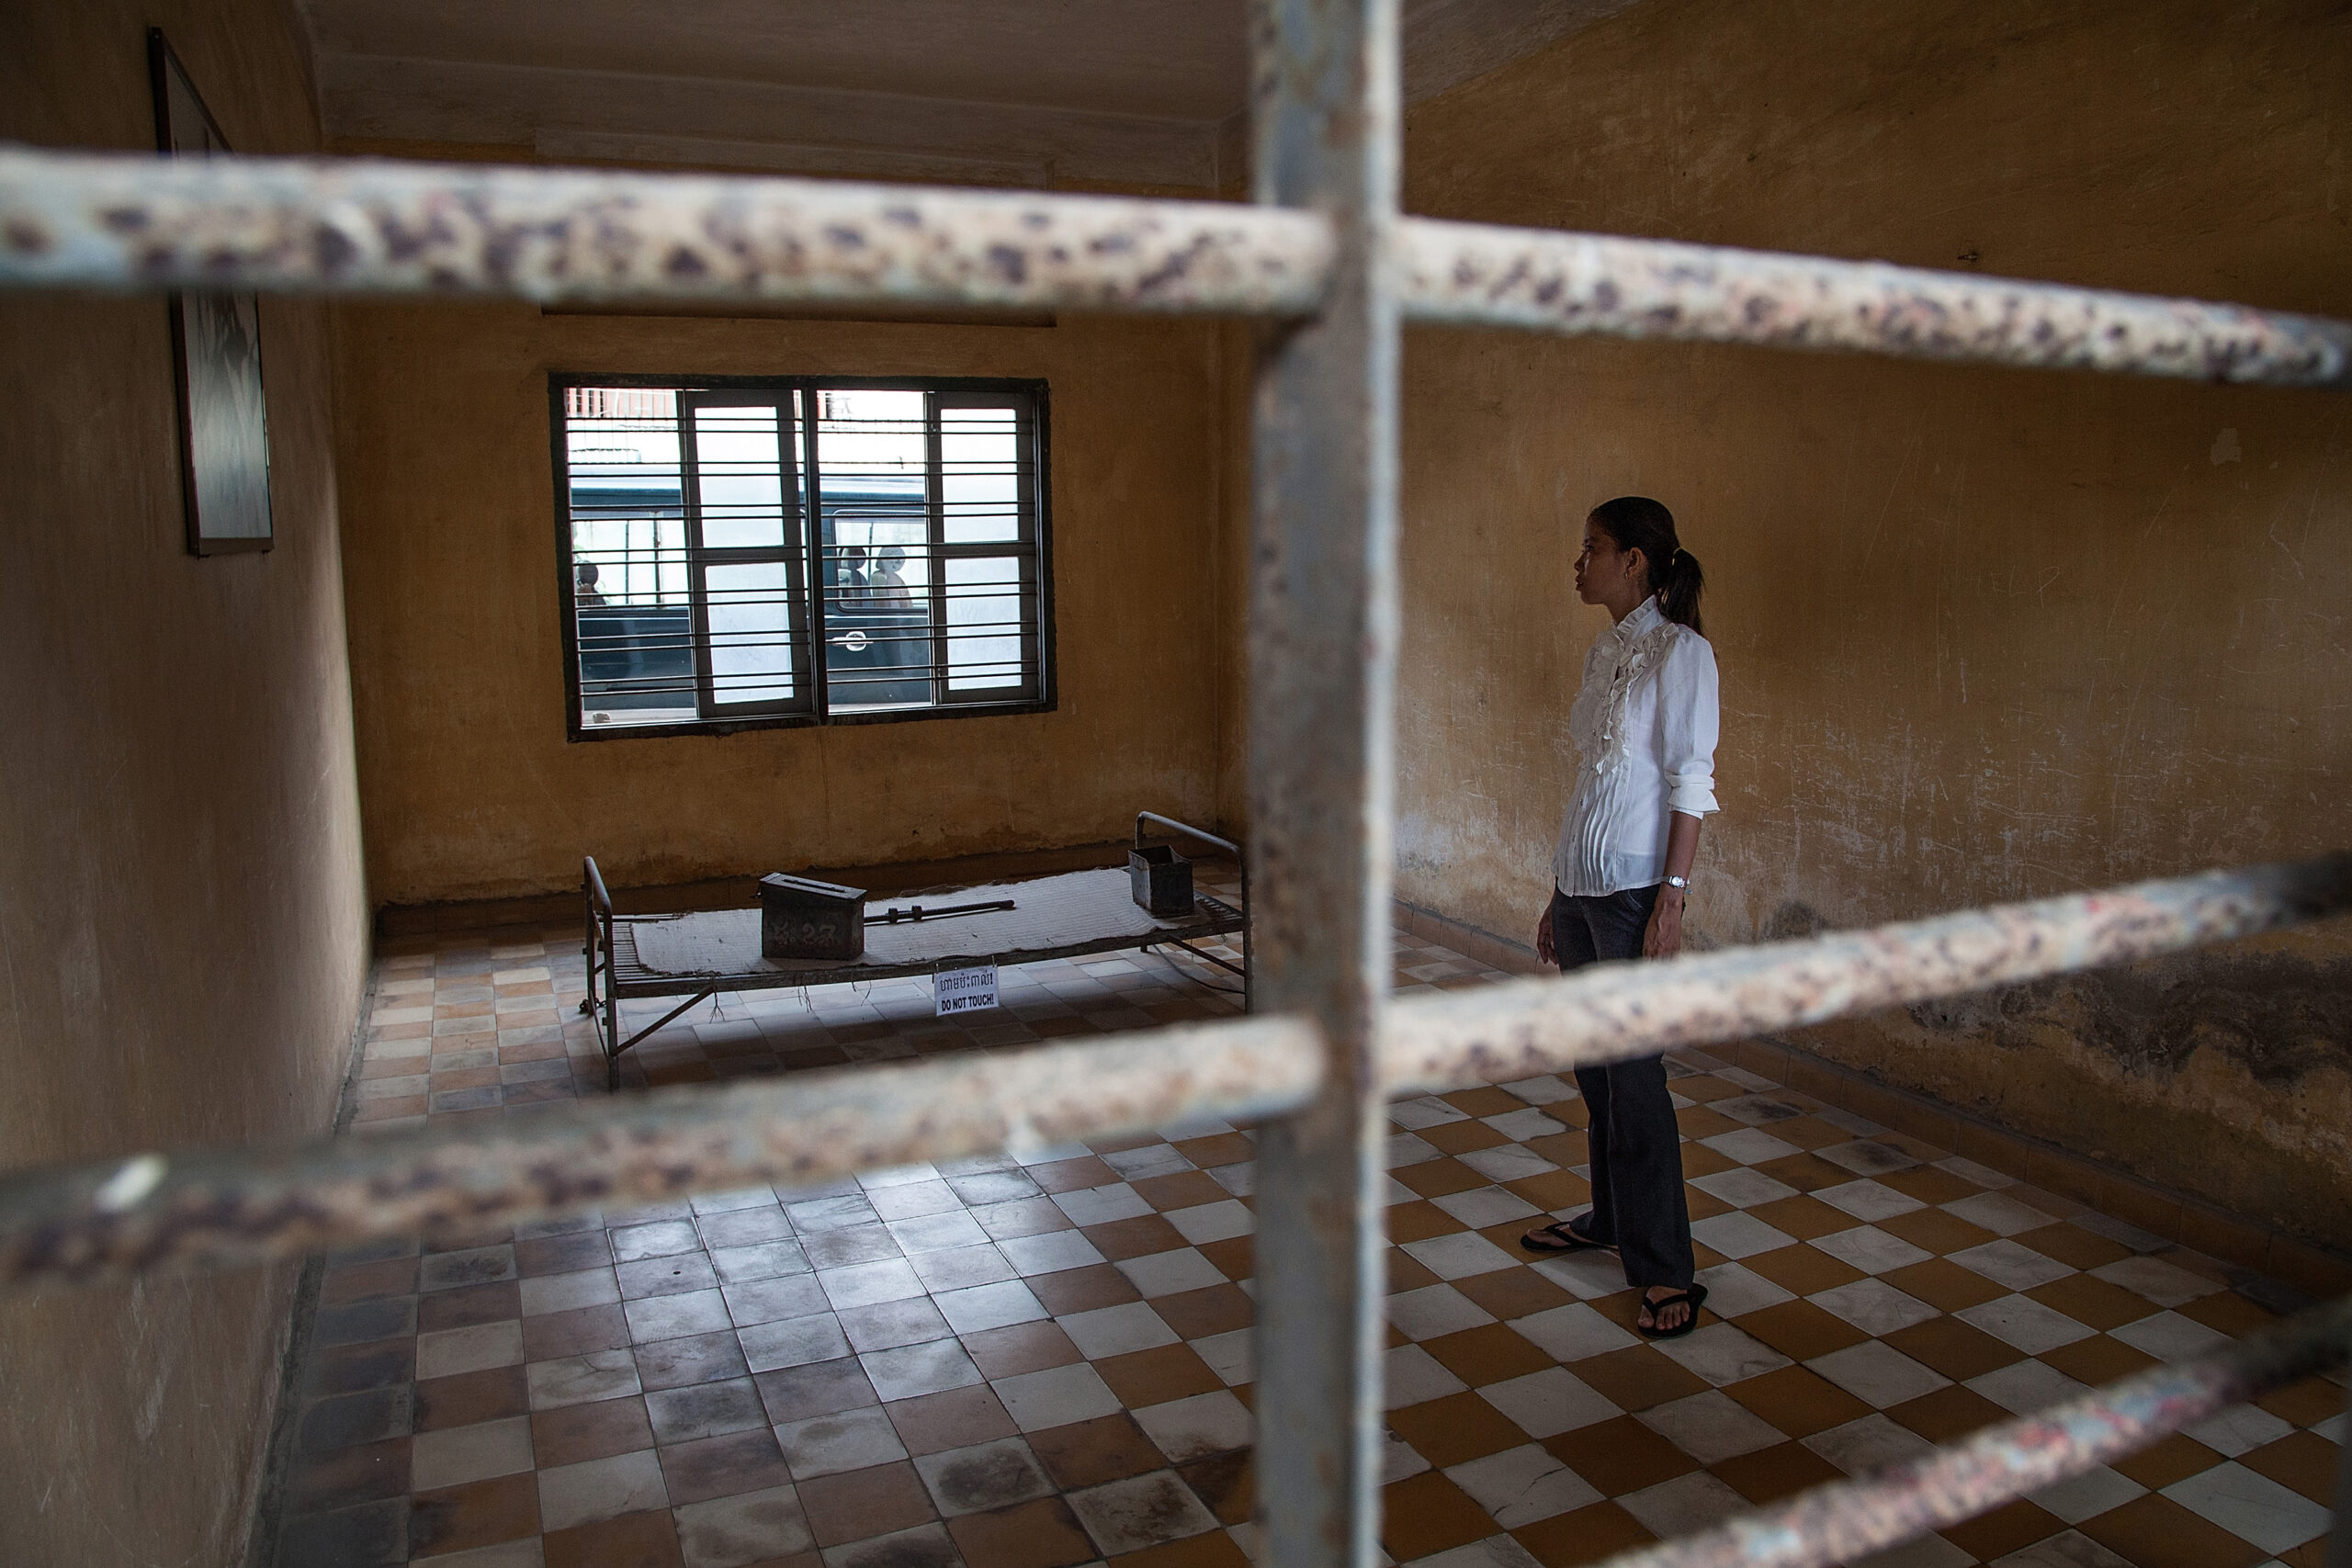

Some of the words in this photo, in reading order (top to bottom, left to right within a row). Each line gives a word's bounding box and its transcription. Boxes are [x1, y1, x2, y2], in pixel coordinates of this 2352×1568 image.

[942, 999, 951, 1012] DO
[953, 997, 967, 1010] NOT
[968, 993, 994, 1008] TOUCH!
